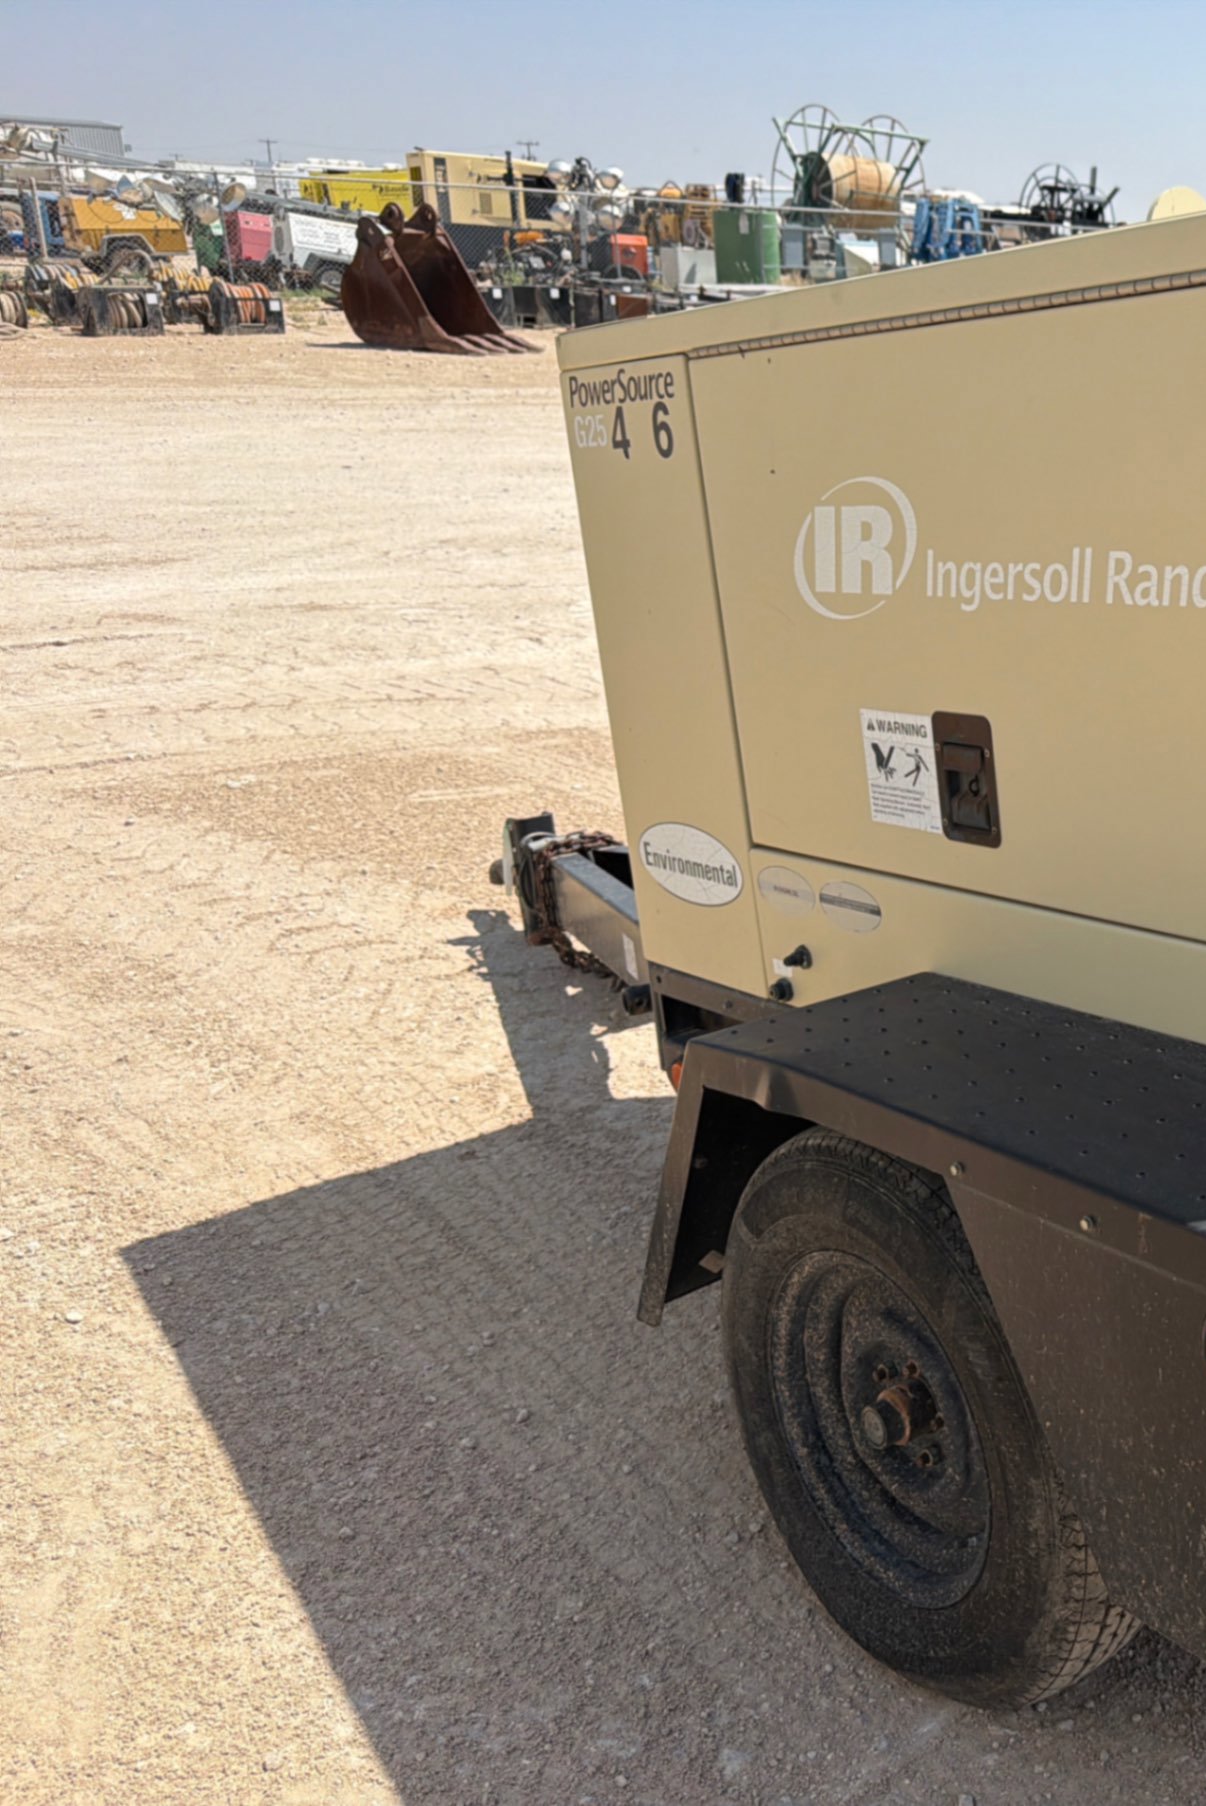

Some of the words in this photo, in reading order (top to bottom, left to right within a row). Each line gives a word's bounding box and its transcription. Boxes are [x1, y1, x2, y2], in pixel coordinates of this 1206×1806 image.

[568, 368, 676, 408] PowerSource
[574, 414, 609, 448] G25
[812, 504, 896, 596] IR
[925, 547, 1094, 612] Ingersoll
[876, 718, 928, 739] WARNING
[643, 842, 739, 888] Environmental
